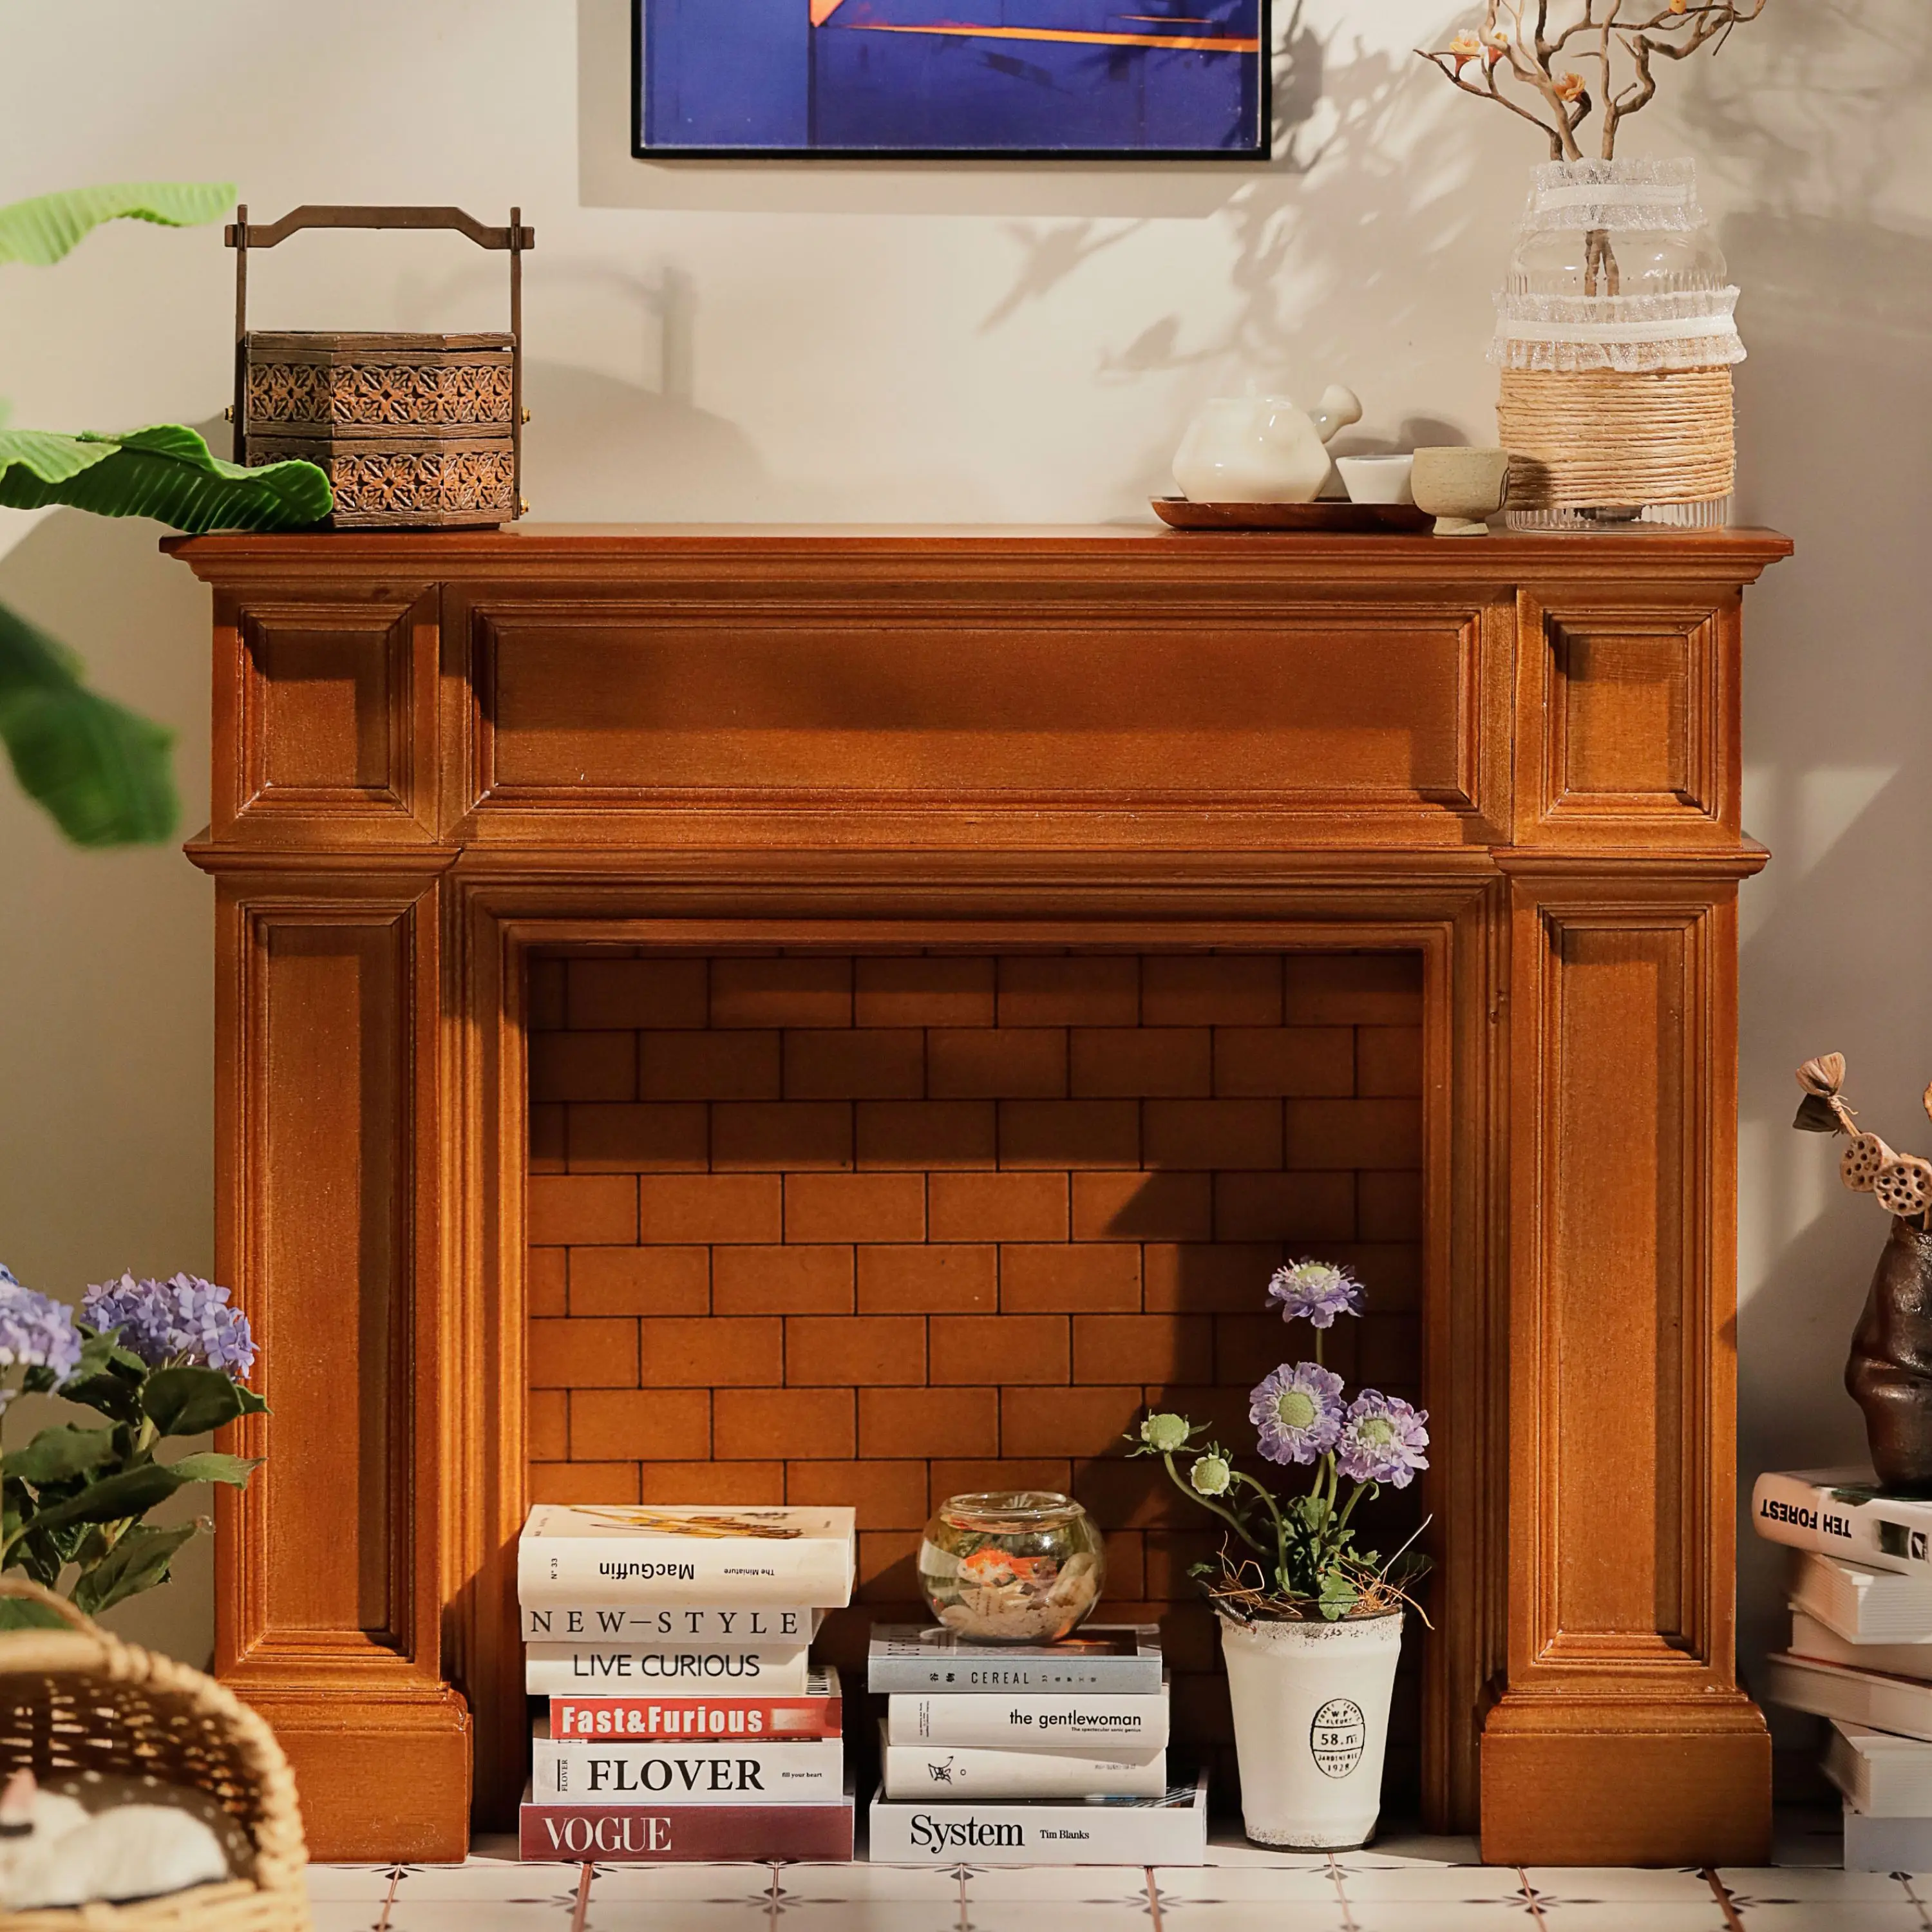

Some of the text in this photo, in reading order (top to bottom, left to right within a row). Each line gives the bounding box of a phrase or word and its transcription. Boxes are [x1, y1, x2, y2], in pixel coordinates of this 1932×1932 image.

[1760, 1499, 1852, 1539] TEH FOREST
[551, 1558, 558, 1567] 33
[600, 1562, 694, 1580] MacGuffin
[573, 1654, 760, 1677] LIVE CURIOUS
[971, 1672, 1029, 1684] CEREAL
[562, 1707, 762, 1734] Fast&Furious
[1009, 1709, 1142, 1729] the gentlewoman
[587, 1759, 765, 1791] FLOVER
[1328, 1763, 1350, 1772] 1928
[542, 1817, 672, 1852] VOGUE
[911, 1814, 1090, 1854] System Tim Blanks
